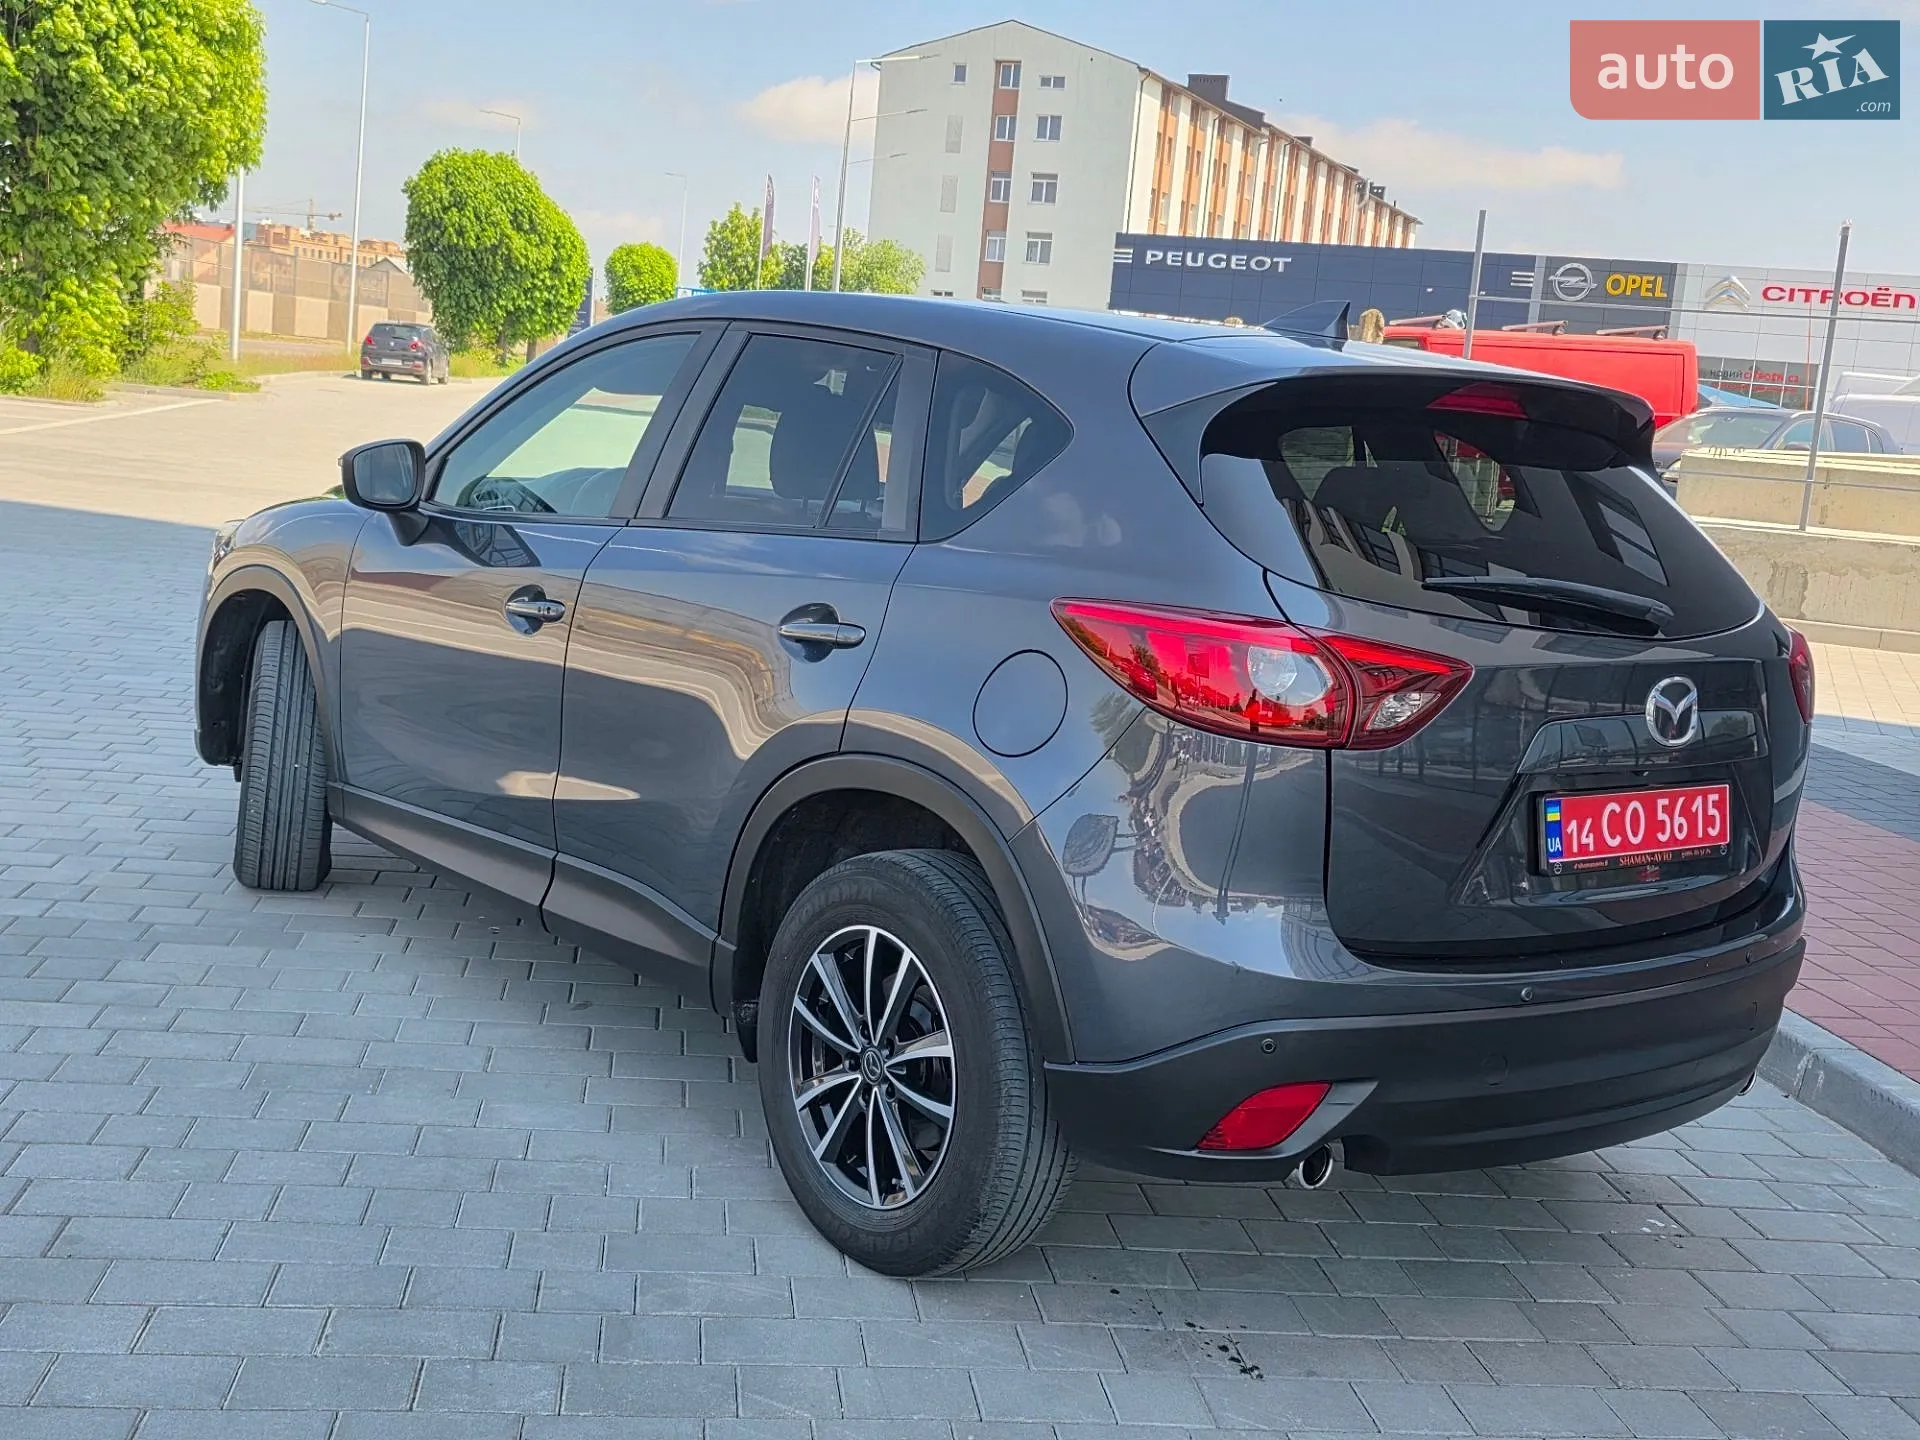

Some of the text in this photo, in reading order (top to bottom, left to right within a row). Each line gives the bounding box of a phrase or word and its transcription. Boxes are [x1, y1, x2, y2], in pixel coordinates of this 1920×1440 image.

[1144, 248, 1292, 273] PEUGEOT
[1605, 272, 1668, 298] OPEL
[1566, 793, 1721, 853] 14 CO 5615
[1547, 837, 1562, 853] UA
